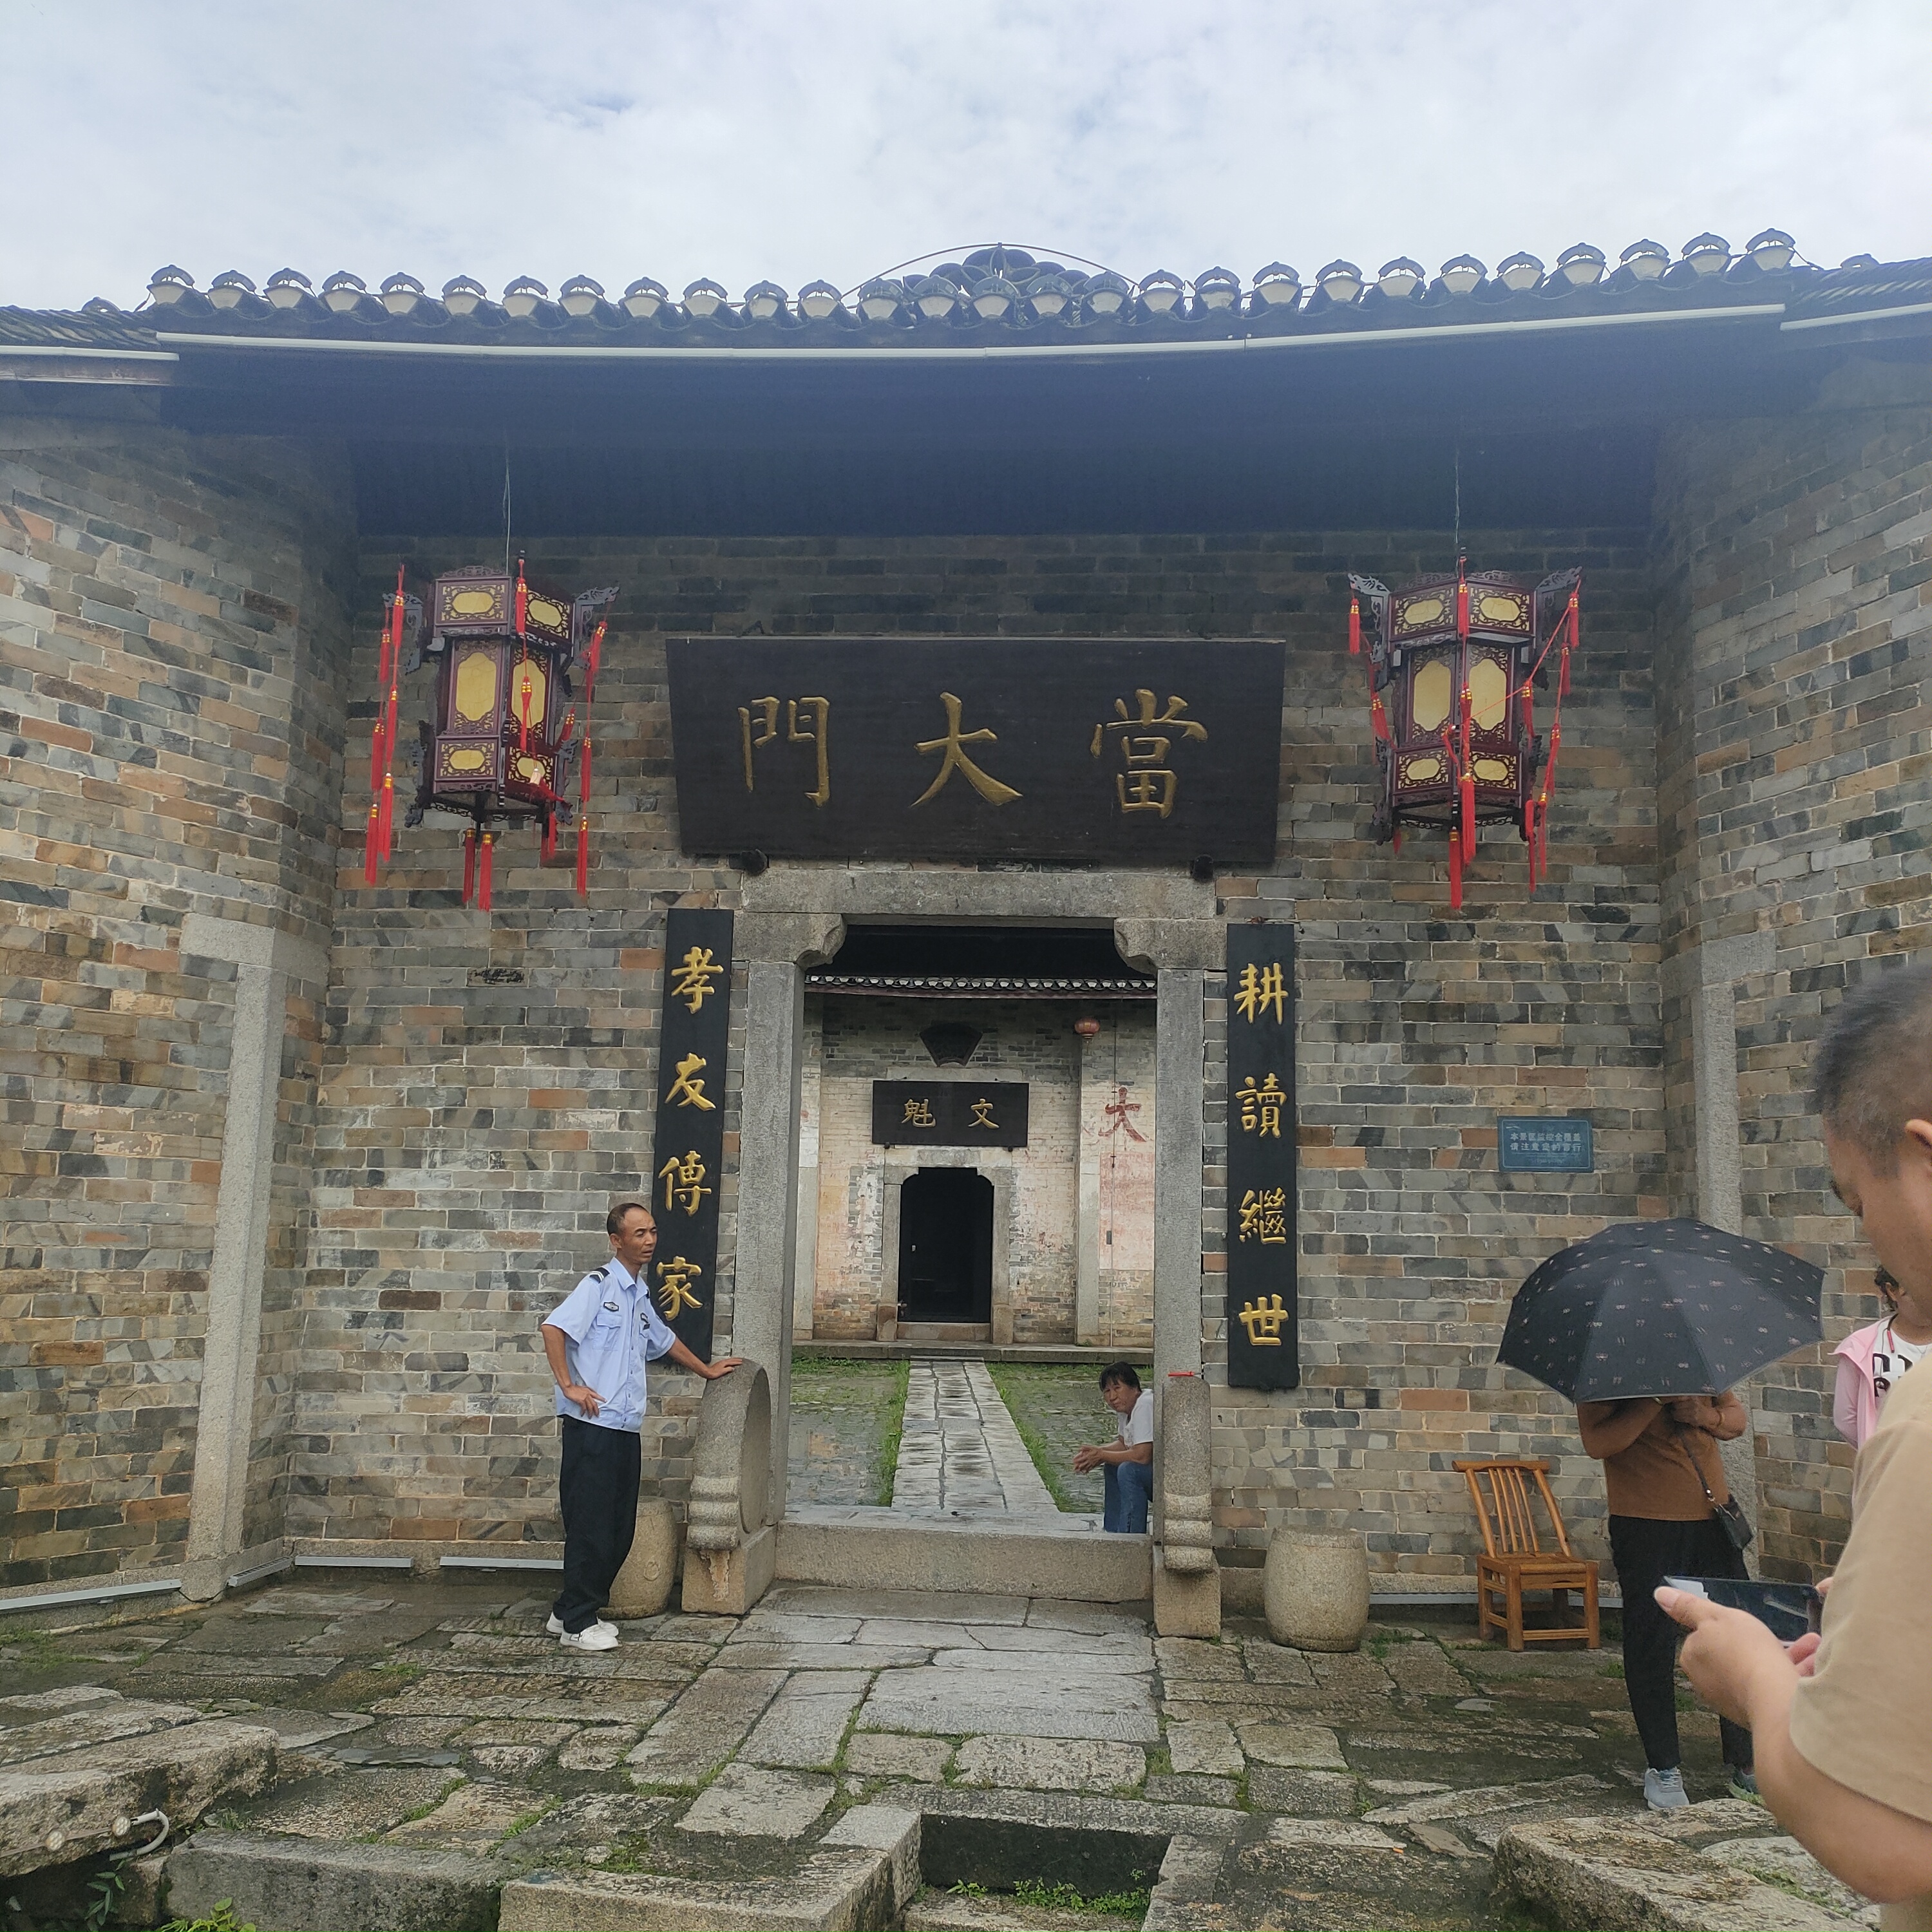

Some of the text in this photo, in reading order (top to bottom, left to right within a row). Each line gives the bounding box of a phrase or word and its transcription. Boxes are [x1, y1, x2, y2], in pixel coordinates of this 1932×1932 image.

[656, 945, 724, 1321] 孝友傳家
[1233, 962, 1289, 1347] 耕讀繼世
